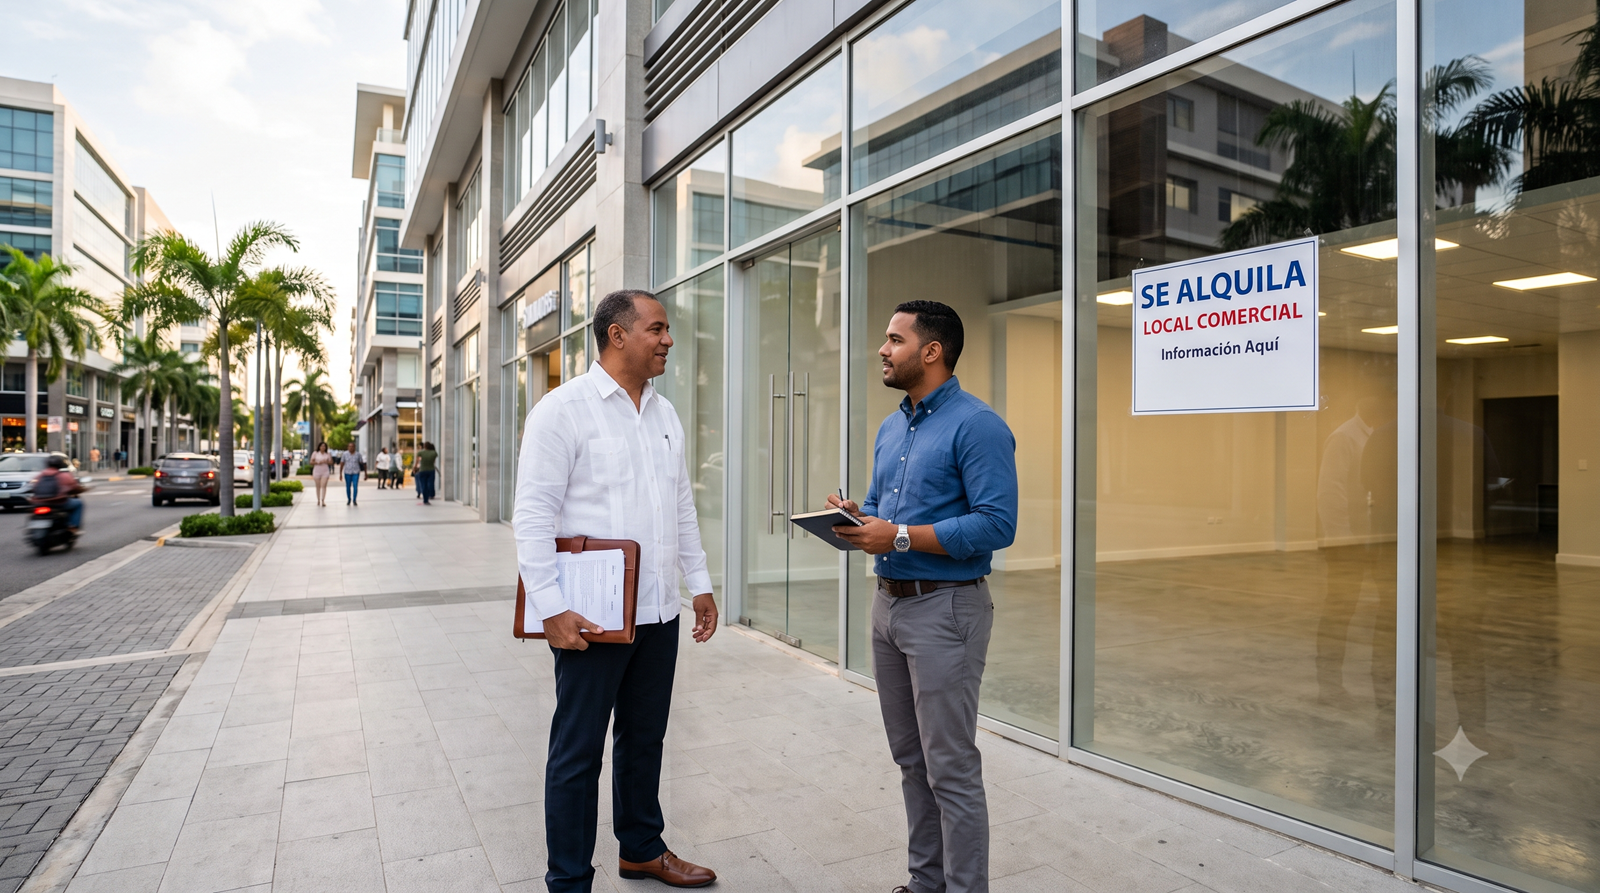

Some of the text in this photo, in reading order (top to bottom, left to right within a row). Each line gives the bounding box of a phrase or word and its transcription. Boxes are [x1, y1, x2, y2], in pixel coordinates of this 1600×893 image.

[1141, 260, 1306, 309] SE ALQUILA
[1143, 302, 1302, 335] LOCAL COMERCIAL
[1161, 336, 1279, 360] Información Aquí
